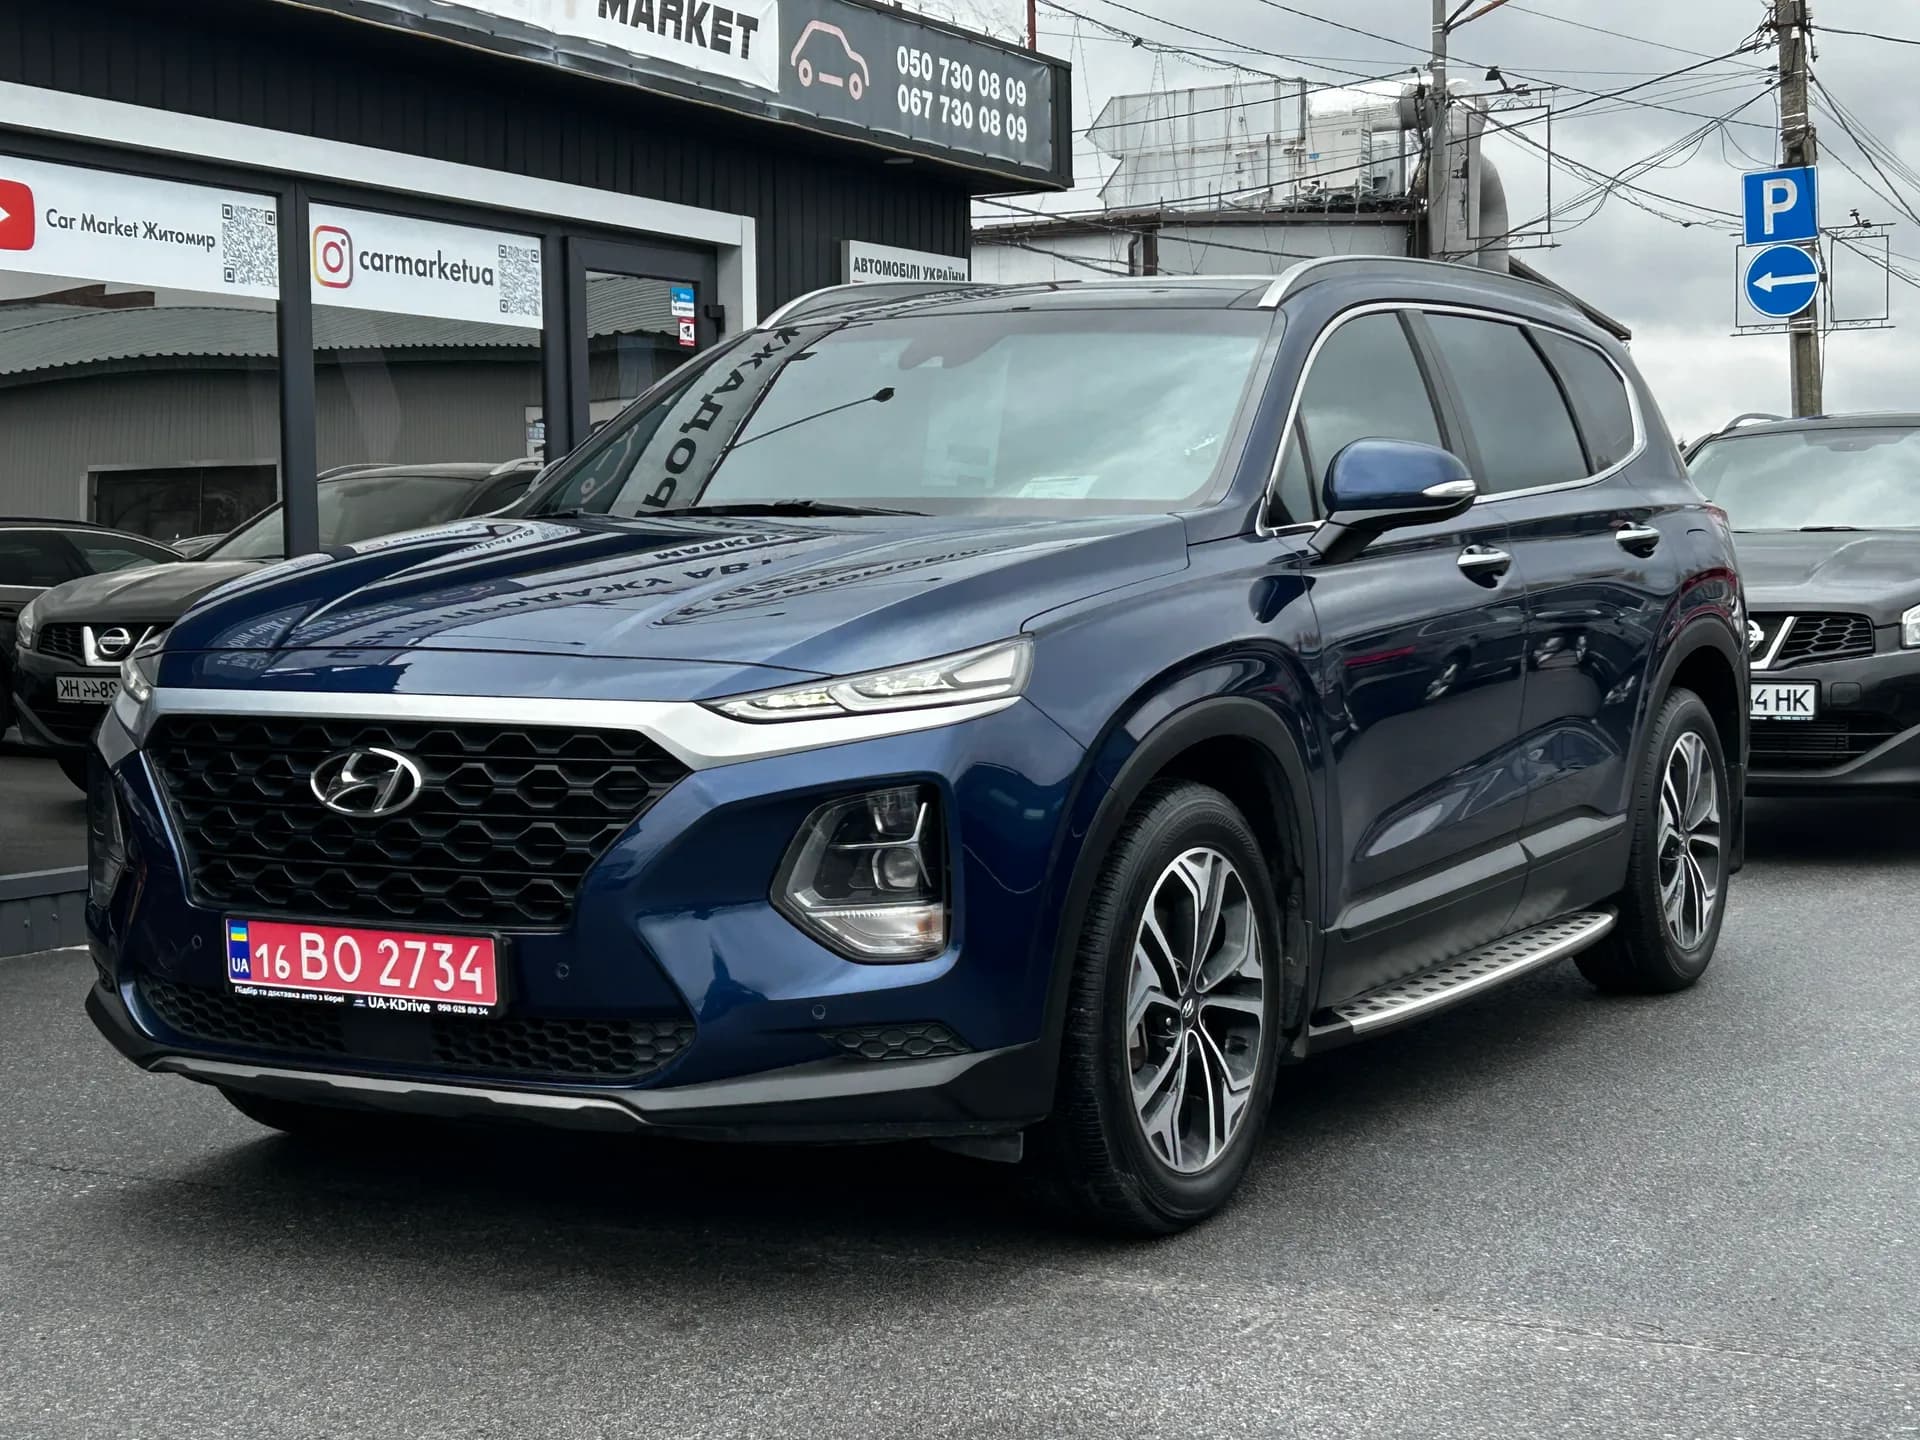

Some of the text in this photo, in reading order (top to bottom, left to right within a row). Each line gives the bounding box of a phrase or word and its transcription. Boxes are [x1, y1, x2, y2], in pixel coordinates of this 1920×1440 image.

[896, 45, 1027, 107] 050 730 08 09
[897, 84, 1028, 143] 067 730 08 09
[1762, 178, 1798, 235] P
[46, 208, 216, 252] Car Market Житомир
[358, 249, 494, 286] carmarketua
[853, 256, 921, 280] АВТОМОБІЛІ
[1776, 689, 1810, 712] HK
[232, 957, 249, 973] UA
[255, 932, 482, 995] 16 BO 2734
